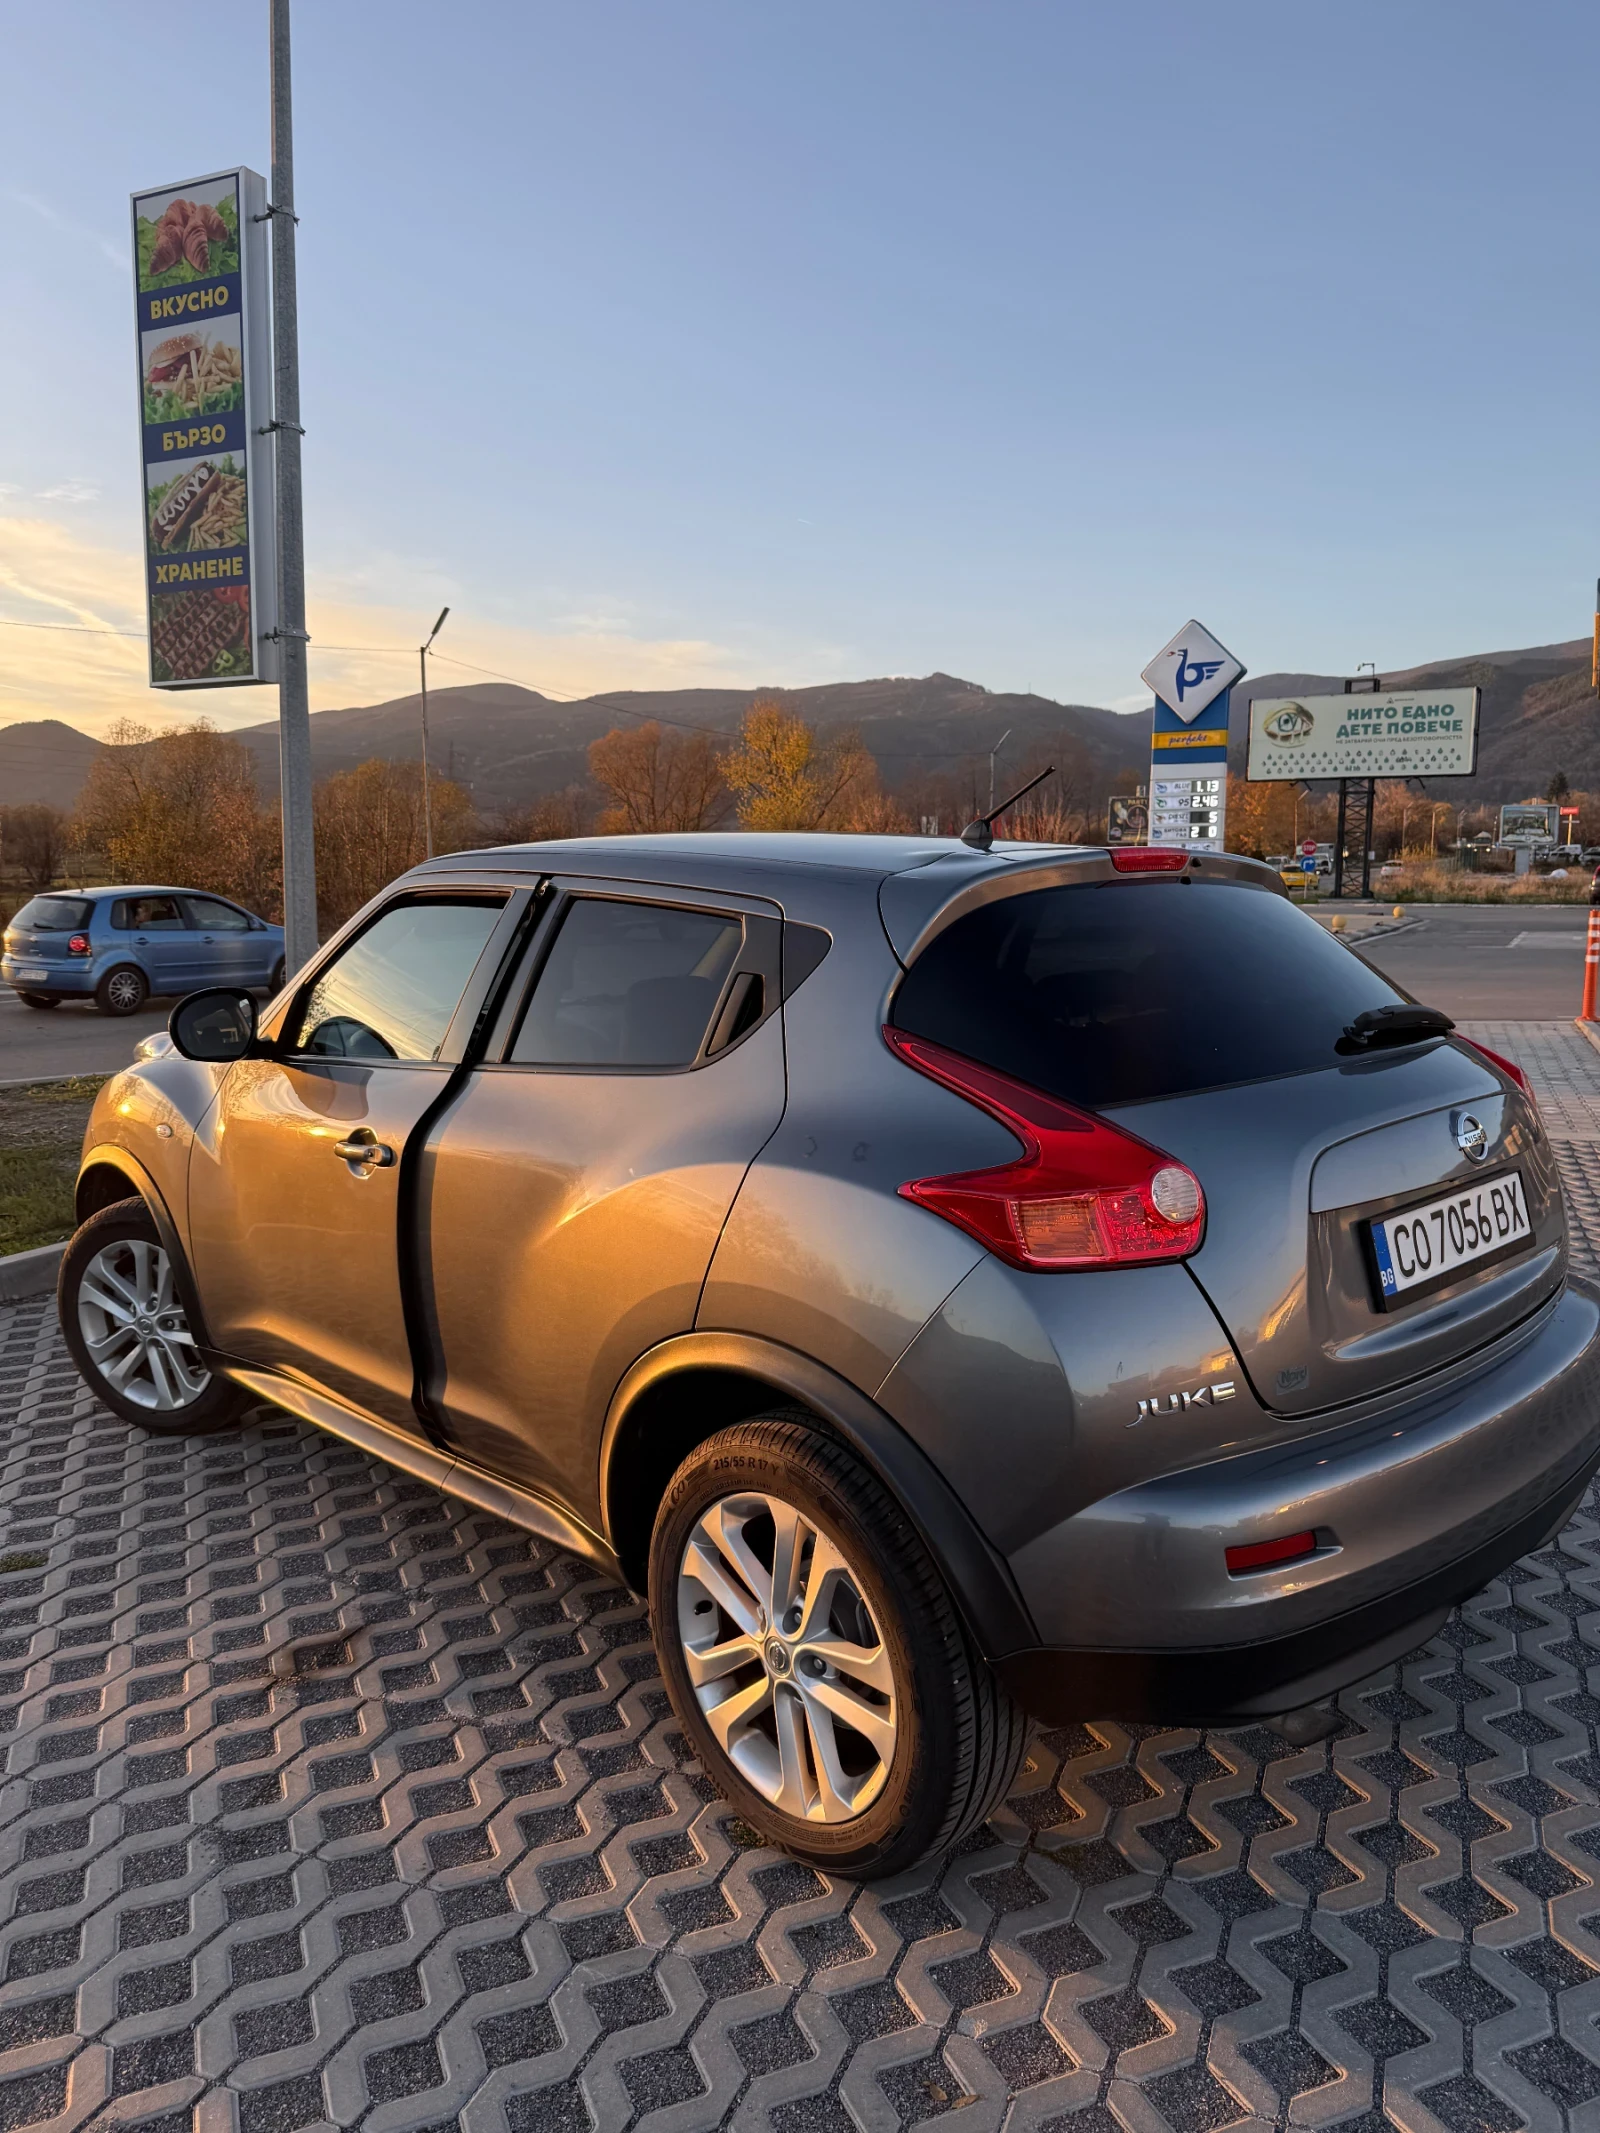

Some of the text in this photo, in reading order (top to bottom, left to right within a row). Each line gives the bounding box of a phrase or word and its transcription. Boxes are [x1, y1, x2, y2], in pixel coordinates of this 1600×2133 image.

[150, 285, 229, 320] ВКУСНО
[162, 424, 226, 451] БЪРЗО
[155, 556, 244, 584] ХРАНЕНЕ
[1347, 703, 1455, 721] НИТО ЕДНО
[1336, 719, 1463, 739] ДЕТЕ ПОВЕЧЕ
[1196, 780, 1219, 792] 1.13
[1178, 798, 1190, 806] 95
[1303, 844, 1316, 852] STOP
[1464, 1131, 1487, 1145] NISS
[1380, 1268, 1394, 1287] BG
[1125, 1381, 1236, 1429] JUKE
[714, 1455, 745, 1471] 215/55
[748, 1457, 756, 1468] R
[758, 1458, 769, 1471] 17
